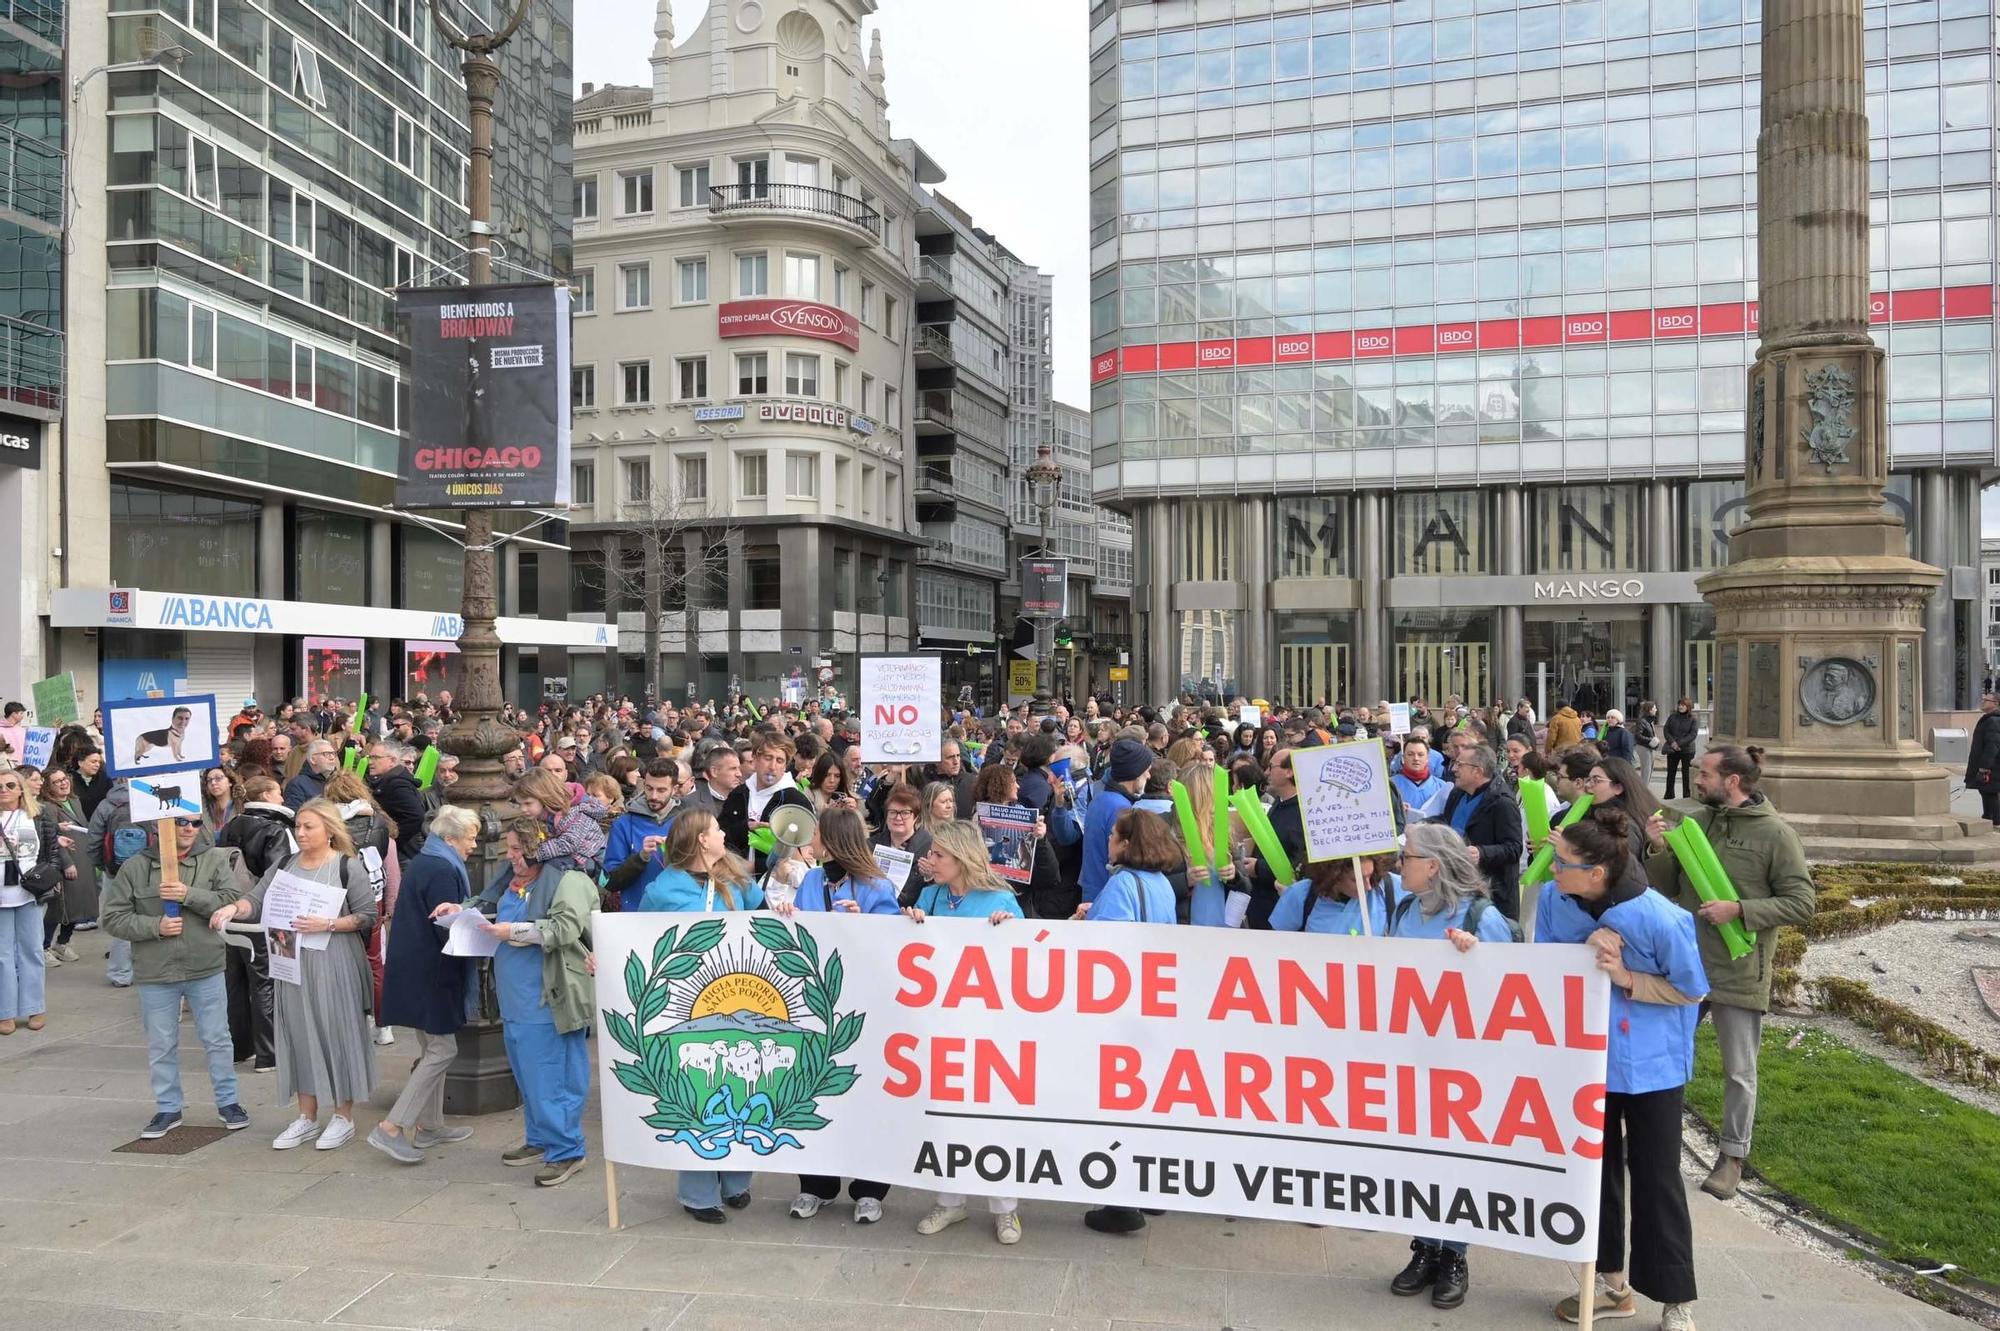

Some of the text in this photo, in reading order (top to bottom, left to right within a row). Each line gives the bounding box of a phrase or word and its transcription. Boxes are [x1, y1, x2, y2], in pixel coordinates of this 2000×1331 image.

[440, 302, 514, 319] BIENVENIDOS A
[720, 313, 770, 324] CENTRO CAPILAR
[778, 306, 839, 331] SVENSON
[1662, 315, 1693, 327] BDO
[440, 317, 515, 338] BROADWAY
[1572, 321, 1603, 333] BDO
[1361, 336, 1389, 348] BDO
[1443, 330, 1473, 342] BDO
[1206, 347, 1231, 358] BDO
[1283, 341, 1309, 353] BDO
[494, 354, 539, 365] DE NUEVA YORK
[695, 406, 742, 419] ASESORIA
[761, 404, 845, 425] avante
[415, 446, 542, 471] CHICAGO
[445, 481, 504, 495] 4 ÚNICOS DÍAS
[1534, 579, 1644, 598] MANGO
[333, 655, 360, 665] Hipoteca
[343, 667, 361, 675] Joven
[1014, 676, 1032, 688] 50%
[875, 704, 919, 726] NO
[991, 806, 1032, 817] SALUD ANIMAL
[1308, 810, 1390, 827] MEXAN POR MIN
[1322, 825, 1348, 836] TEÑO
[1351, 824, 1370, 833] QUE
[1312, 831, 1395, 846] DECIR QUE CHOVE
[702, 978, 778, 1004] HIGIA PECORIS
[895, 929, 1607, 1051] SAÚDE ANIMAL
[706, 987, 772, 1014] SALUS POPULI
[883, 1032, 1607, 1160] SEN BARREIRAS
[914, 1141, 1587, 1246] APOIA Ó TEU VETERINARIO
